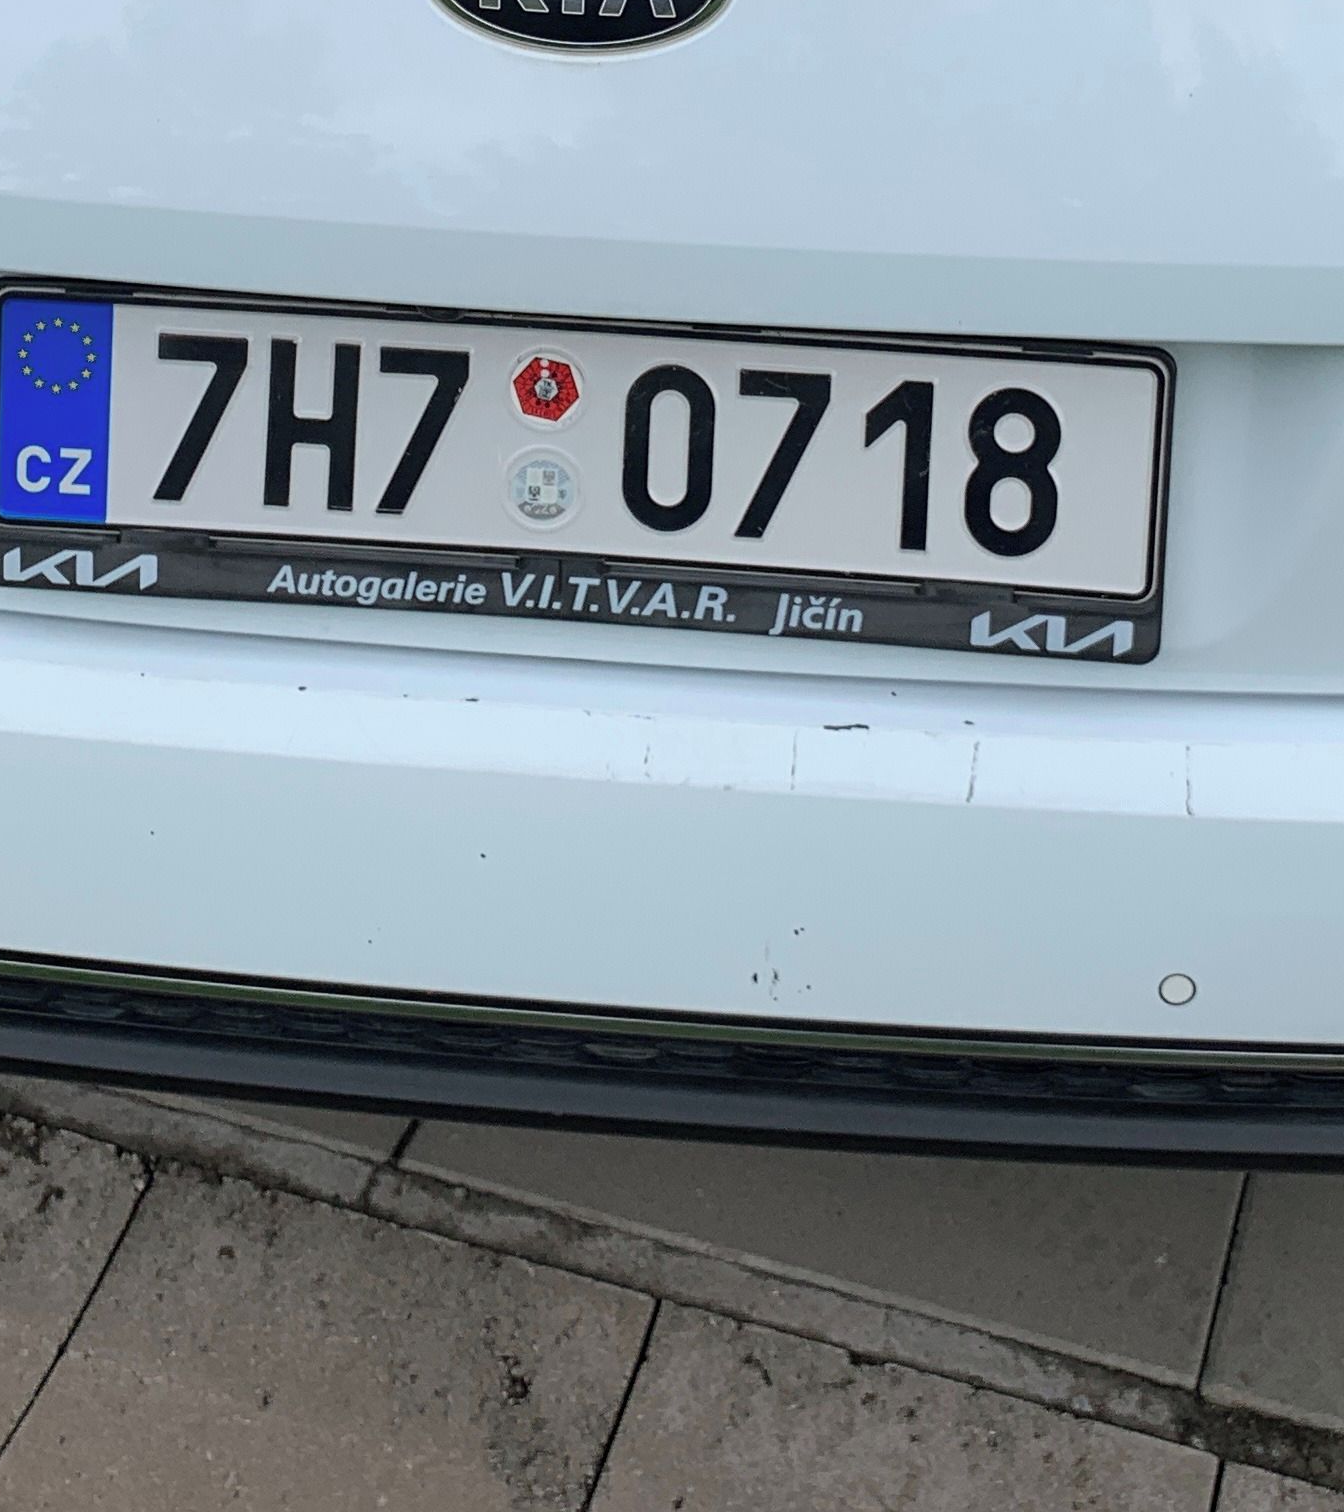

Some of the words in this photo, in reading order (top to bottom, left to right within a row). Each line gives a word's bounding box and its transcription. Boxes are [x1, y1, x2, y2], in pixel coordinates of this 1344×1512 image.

[15, 444, 93, 496] CZ
[152, 332, 472, 516] 7H7
[621, 363, 1062, 558] 0718
[2, 546, 158, 590] KIA
[266, 564, 487, 606] Autogalerie
[500, 571, 737, 623] V.I.T.V.A.R.
[768, 592, 864, 636] Jičín
[969, 609, 1135, 657] KIA
